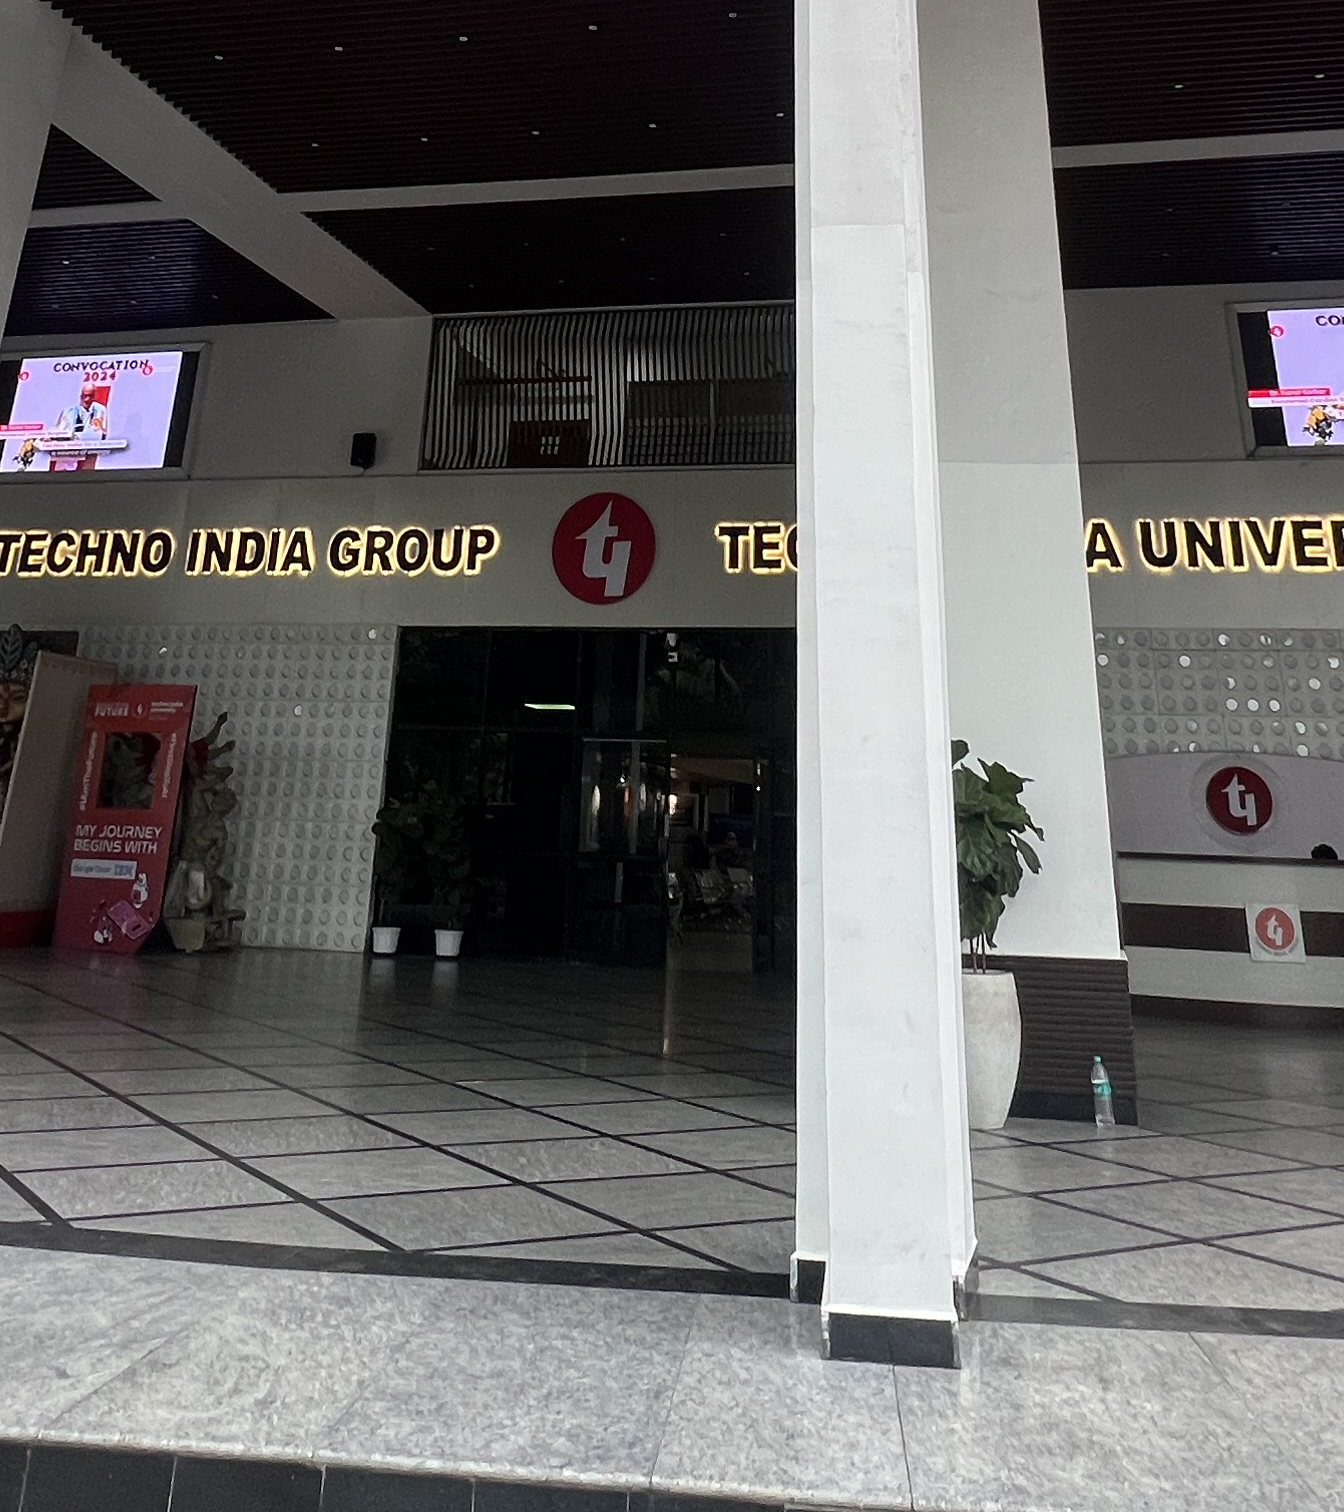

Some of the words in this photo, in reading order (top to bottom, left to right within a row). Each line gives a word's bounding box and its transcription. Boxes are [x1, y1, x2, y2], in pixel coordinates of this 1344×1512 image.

[53, 359, 150, 373] CONVOCATION
[83, 371, 117, 382] 2024
[186, 528, 314, 575] INDIA
[328, 525, 497, 574] GROUP
[716, 523, 797, 572] TE
[76, 825, 97, 837] MY
[99, 825, 162, 839] JOURNEY
[74, 839, 122, 853] BEGINS
[124, 841, 157, 854] WITH
